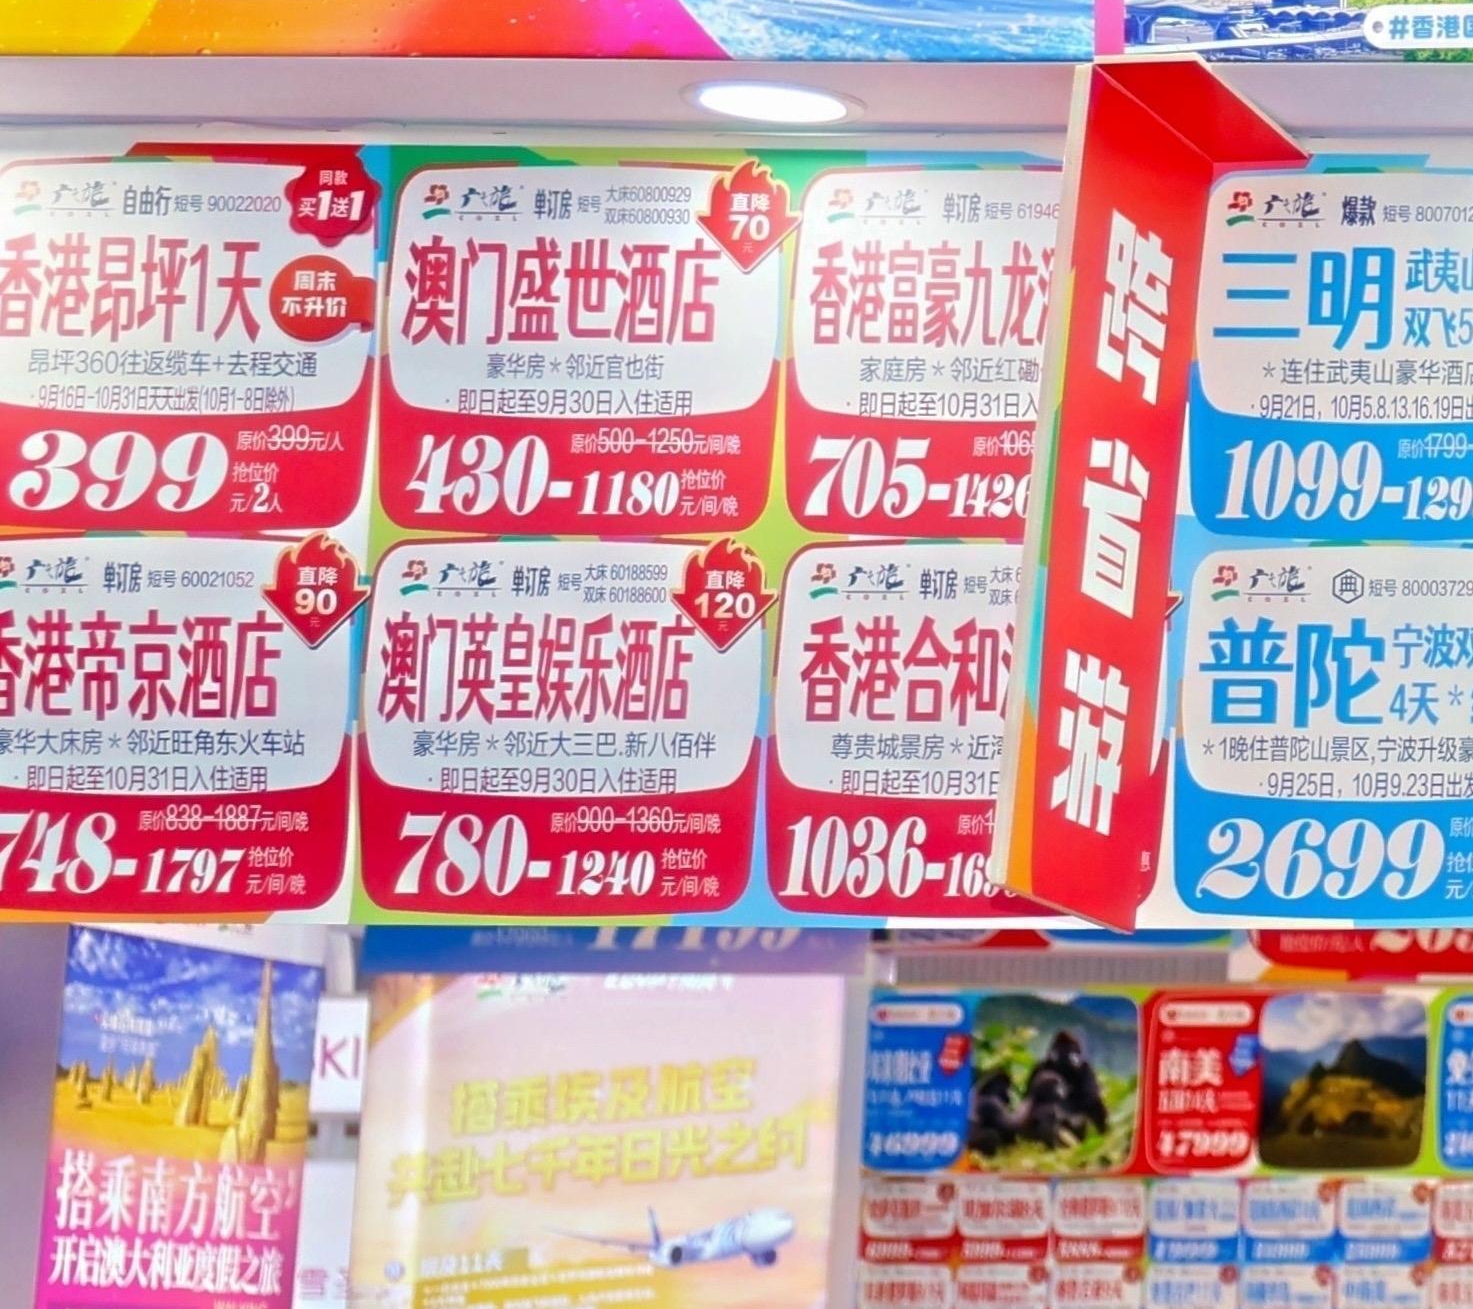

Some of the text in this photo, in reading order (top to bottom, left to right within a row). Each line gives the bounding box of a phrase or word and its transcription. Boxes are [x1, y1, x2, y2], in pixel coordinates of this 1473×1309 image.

[123, 185, 281, 215] 自由行 90022020
[0, 234, 261, 344] 香港昂坪1天
[404, 236, 721, 346] 澳门盛世酒店
[1213, 247, 1395, 350] 三明
[28, 351, 318, 378] 昂坪360往返缆车+去程交通
[9, 429, 229, 513] 399
[1050, 207, 1173, 837] 跨省游
[693, 592, 756, 619] 120
[377, 612, 697, 725] 澳门英皇娱乐酒店
[1200, 617, 1385, 728] 普陀
[1196, 818, 1445, 899] 2699
[49, 1234, 284, 1296] 开启澳大利亚度假之旅
